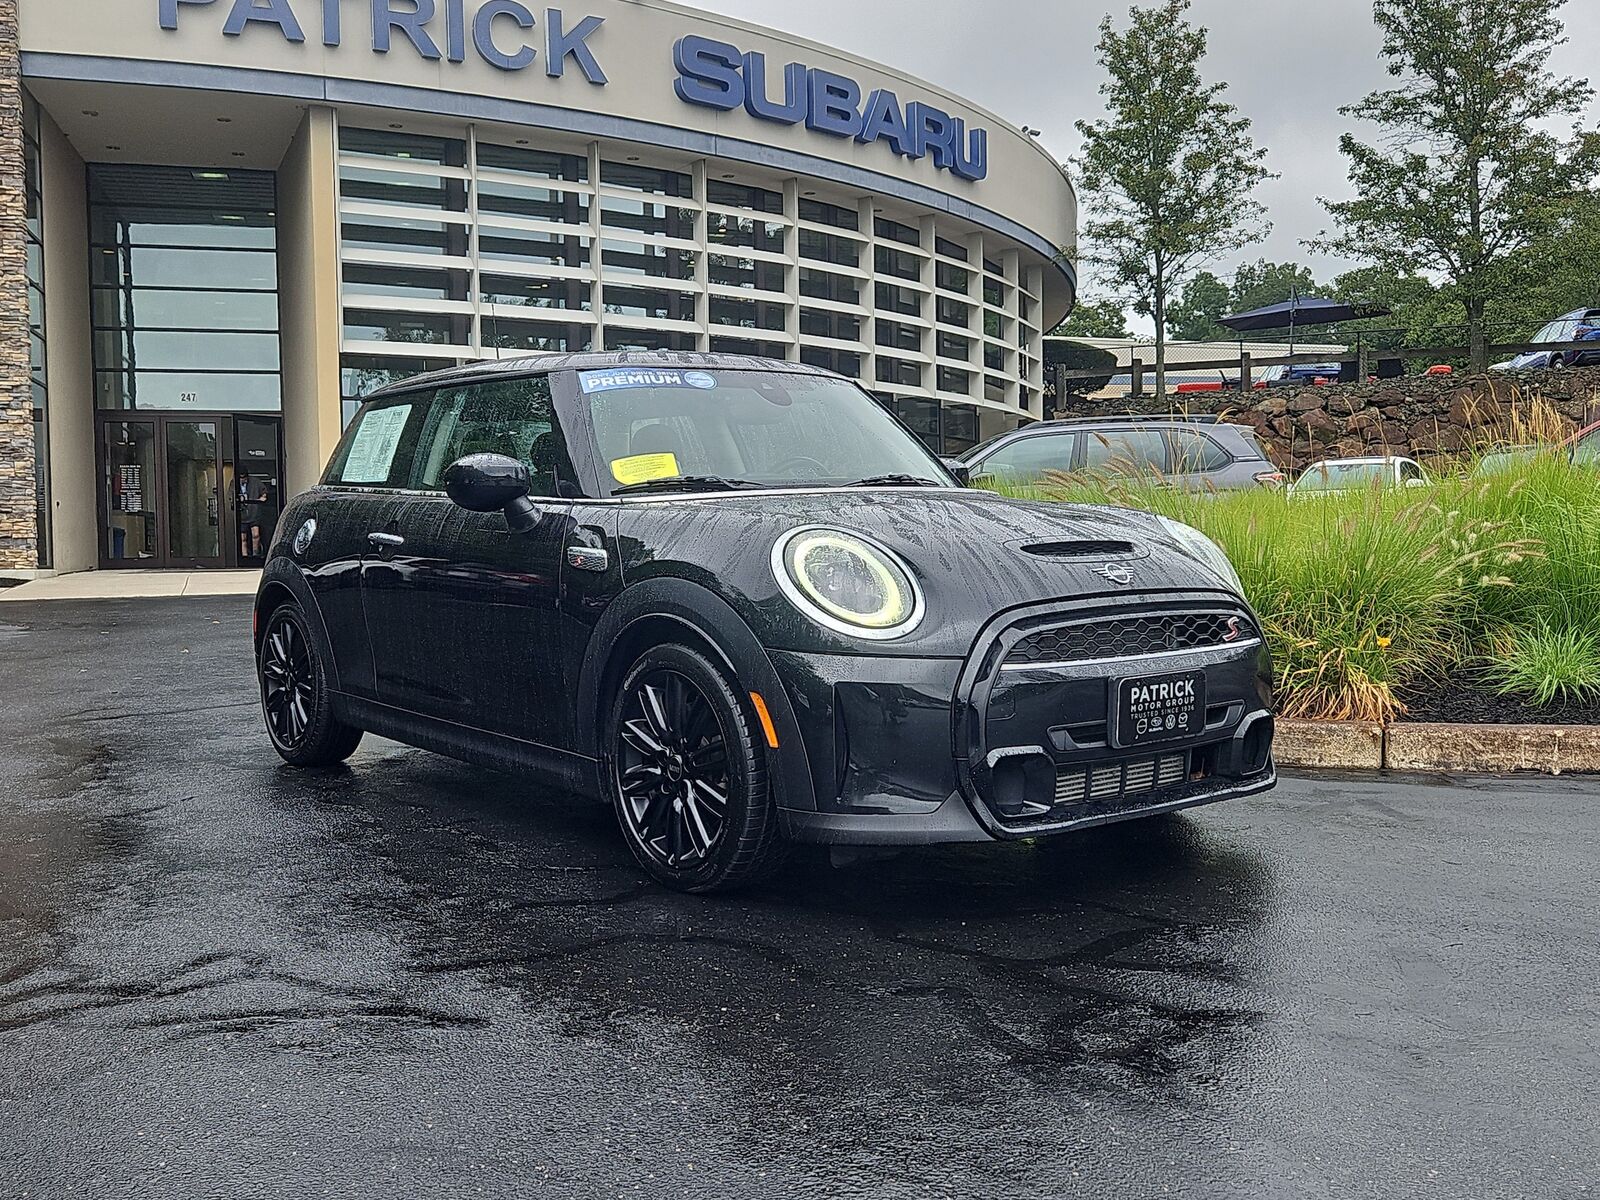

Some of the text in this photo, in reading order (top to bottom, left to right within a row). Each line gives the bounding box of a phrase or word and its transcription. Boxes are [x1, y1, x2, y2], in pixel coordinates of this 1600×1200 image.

[672, 33, 989, 183] SUBARU
[587, 374, 683, 389] PREMIUM
[180, 393, 197, 402] 247
[1222, 616, 1241, 642] S
[1130, 679, 1195, 704] PATRICK
[1130, 696, 1195, 713] MOTOR GROUP
[1130, 710, 1159, 720] TRUSTED
[1160, 707, 1179, 715] SINCE
